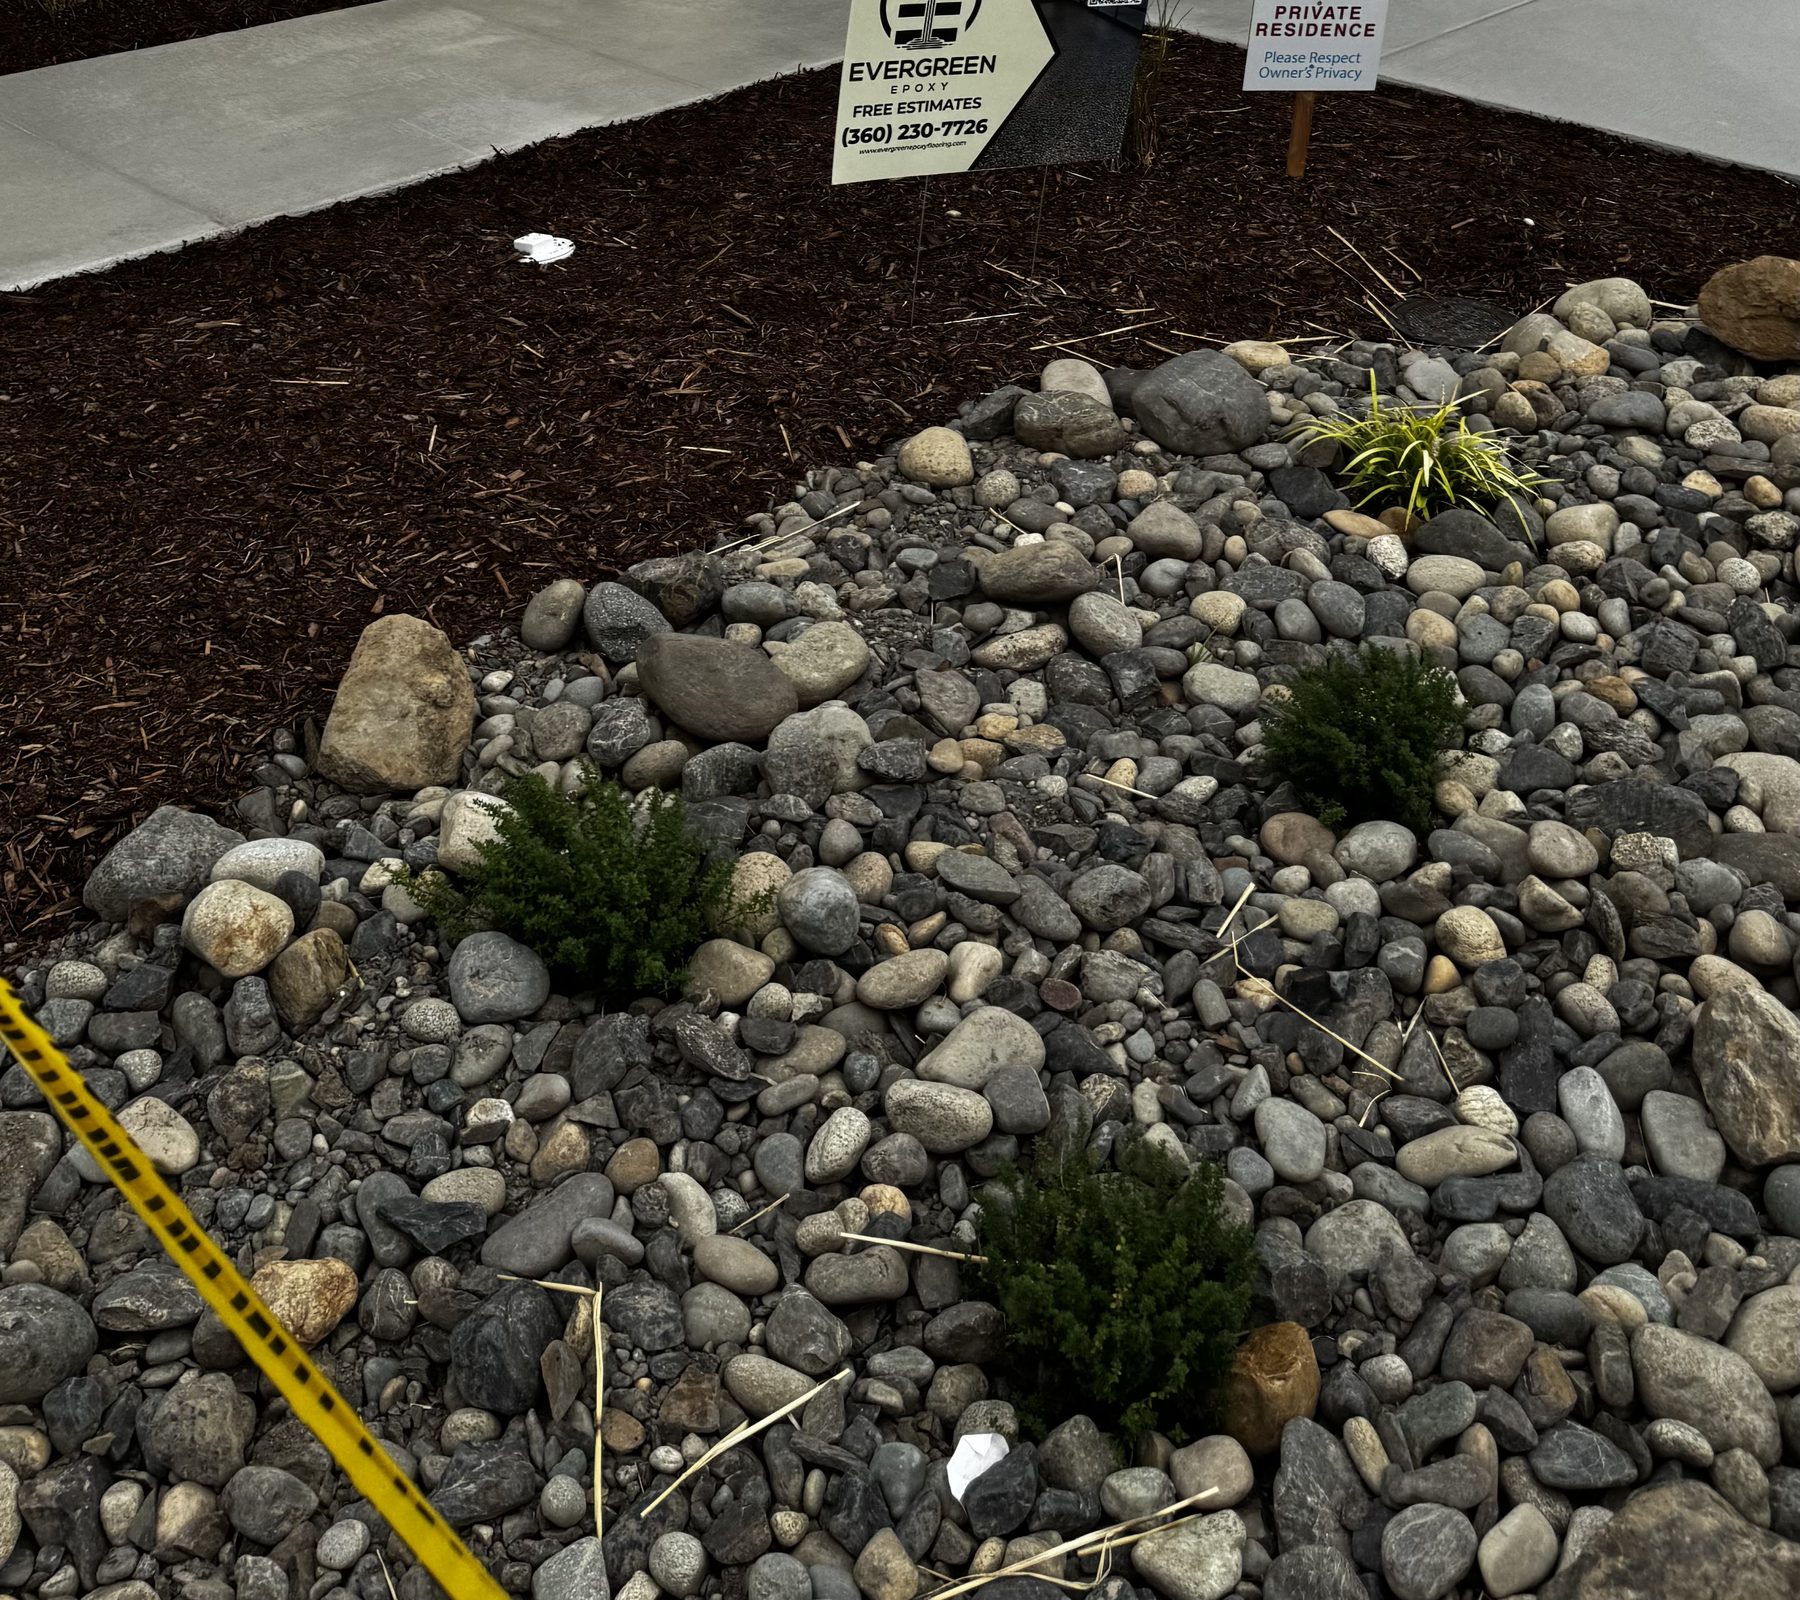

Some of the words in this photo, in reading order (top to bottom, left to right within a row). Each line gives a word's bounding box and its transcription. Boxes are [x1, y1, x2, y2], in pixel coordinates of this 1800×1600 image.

[1274, 5, 1362, 20] PRIVATE
[1255, 22, 1377, 37] RESIDENCE
[1264, 51, 1306, 64] Please
[1309, 51, 1363, 66] Respect
[849, 54, 997, 82] EVERGREEN
[1258, 66, 1312, 79] Owner's
[1315, 66, 1363, 82] Privacy
[890, 81, 949, 95] EPOXY
[852, 103, 894, 118] FREE
[897, 97, 983, 115] ESTIMATES
[841, 123, 893, 148] (360)
[897, 118, 989, 141] 230-7726
